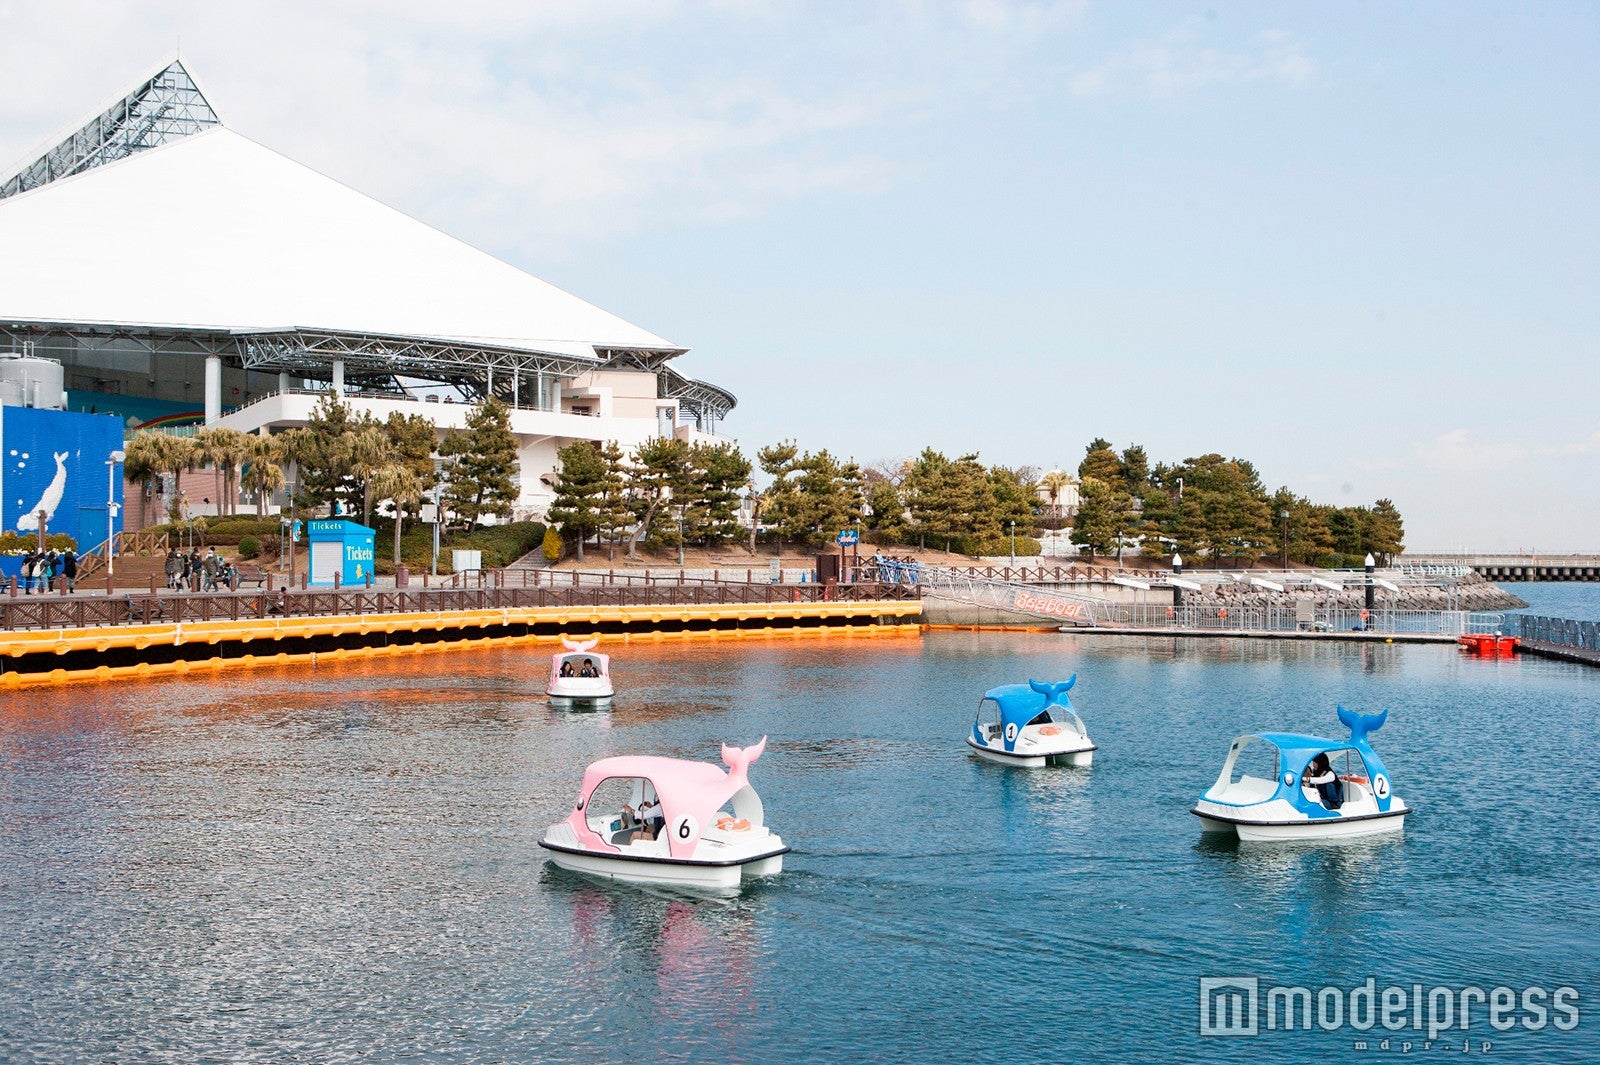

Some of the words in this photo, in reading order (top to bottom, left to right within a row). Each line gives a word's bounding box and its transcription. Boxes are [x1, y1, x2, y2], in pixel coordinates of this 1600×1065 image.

[312, 522, 342, 530] Tickets
[346, 546, 372, 560] Tickets
[1008, 725, 1014, 739] 1
[1378, 777, 1386, 795] 2
[679, 818, 690, 839] 6
